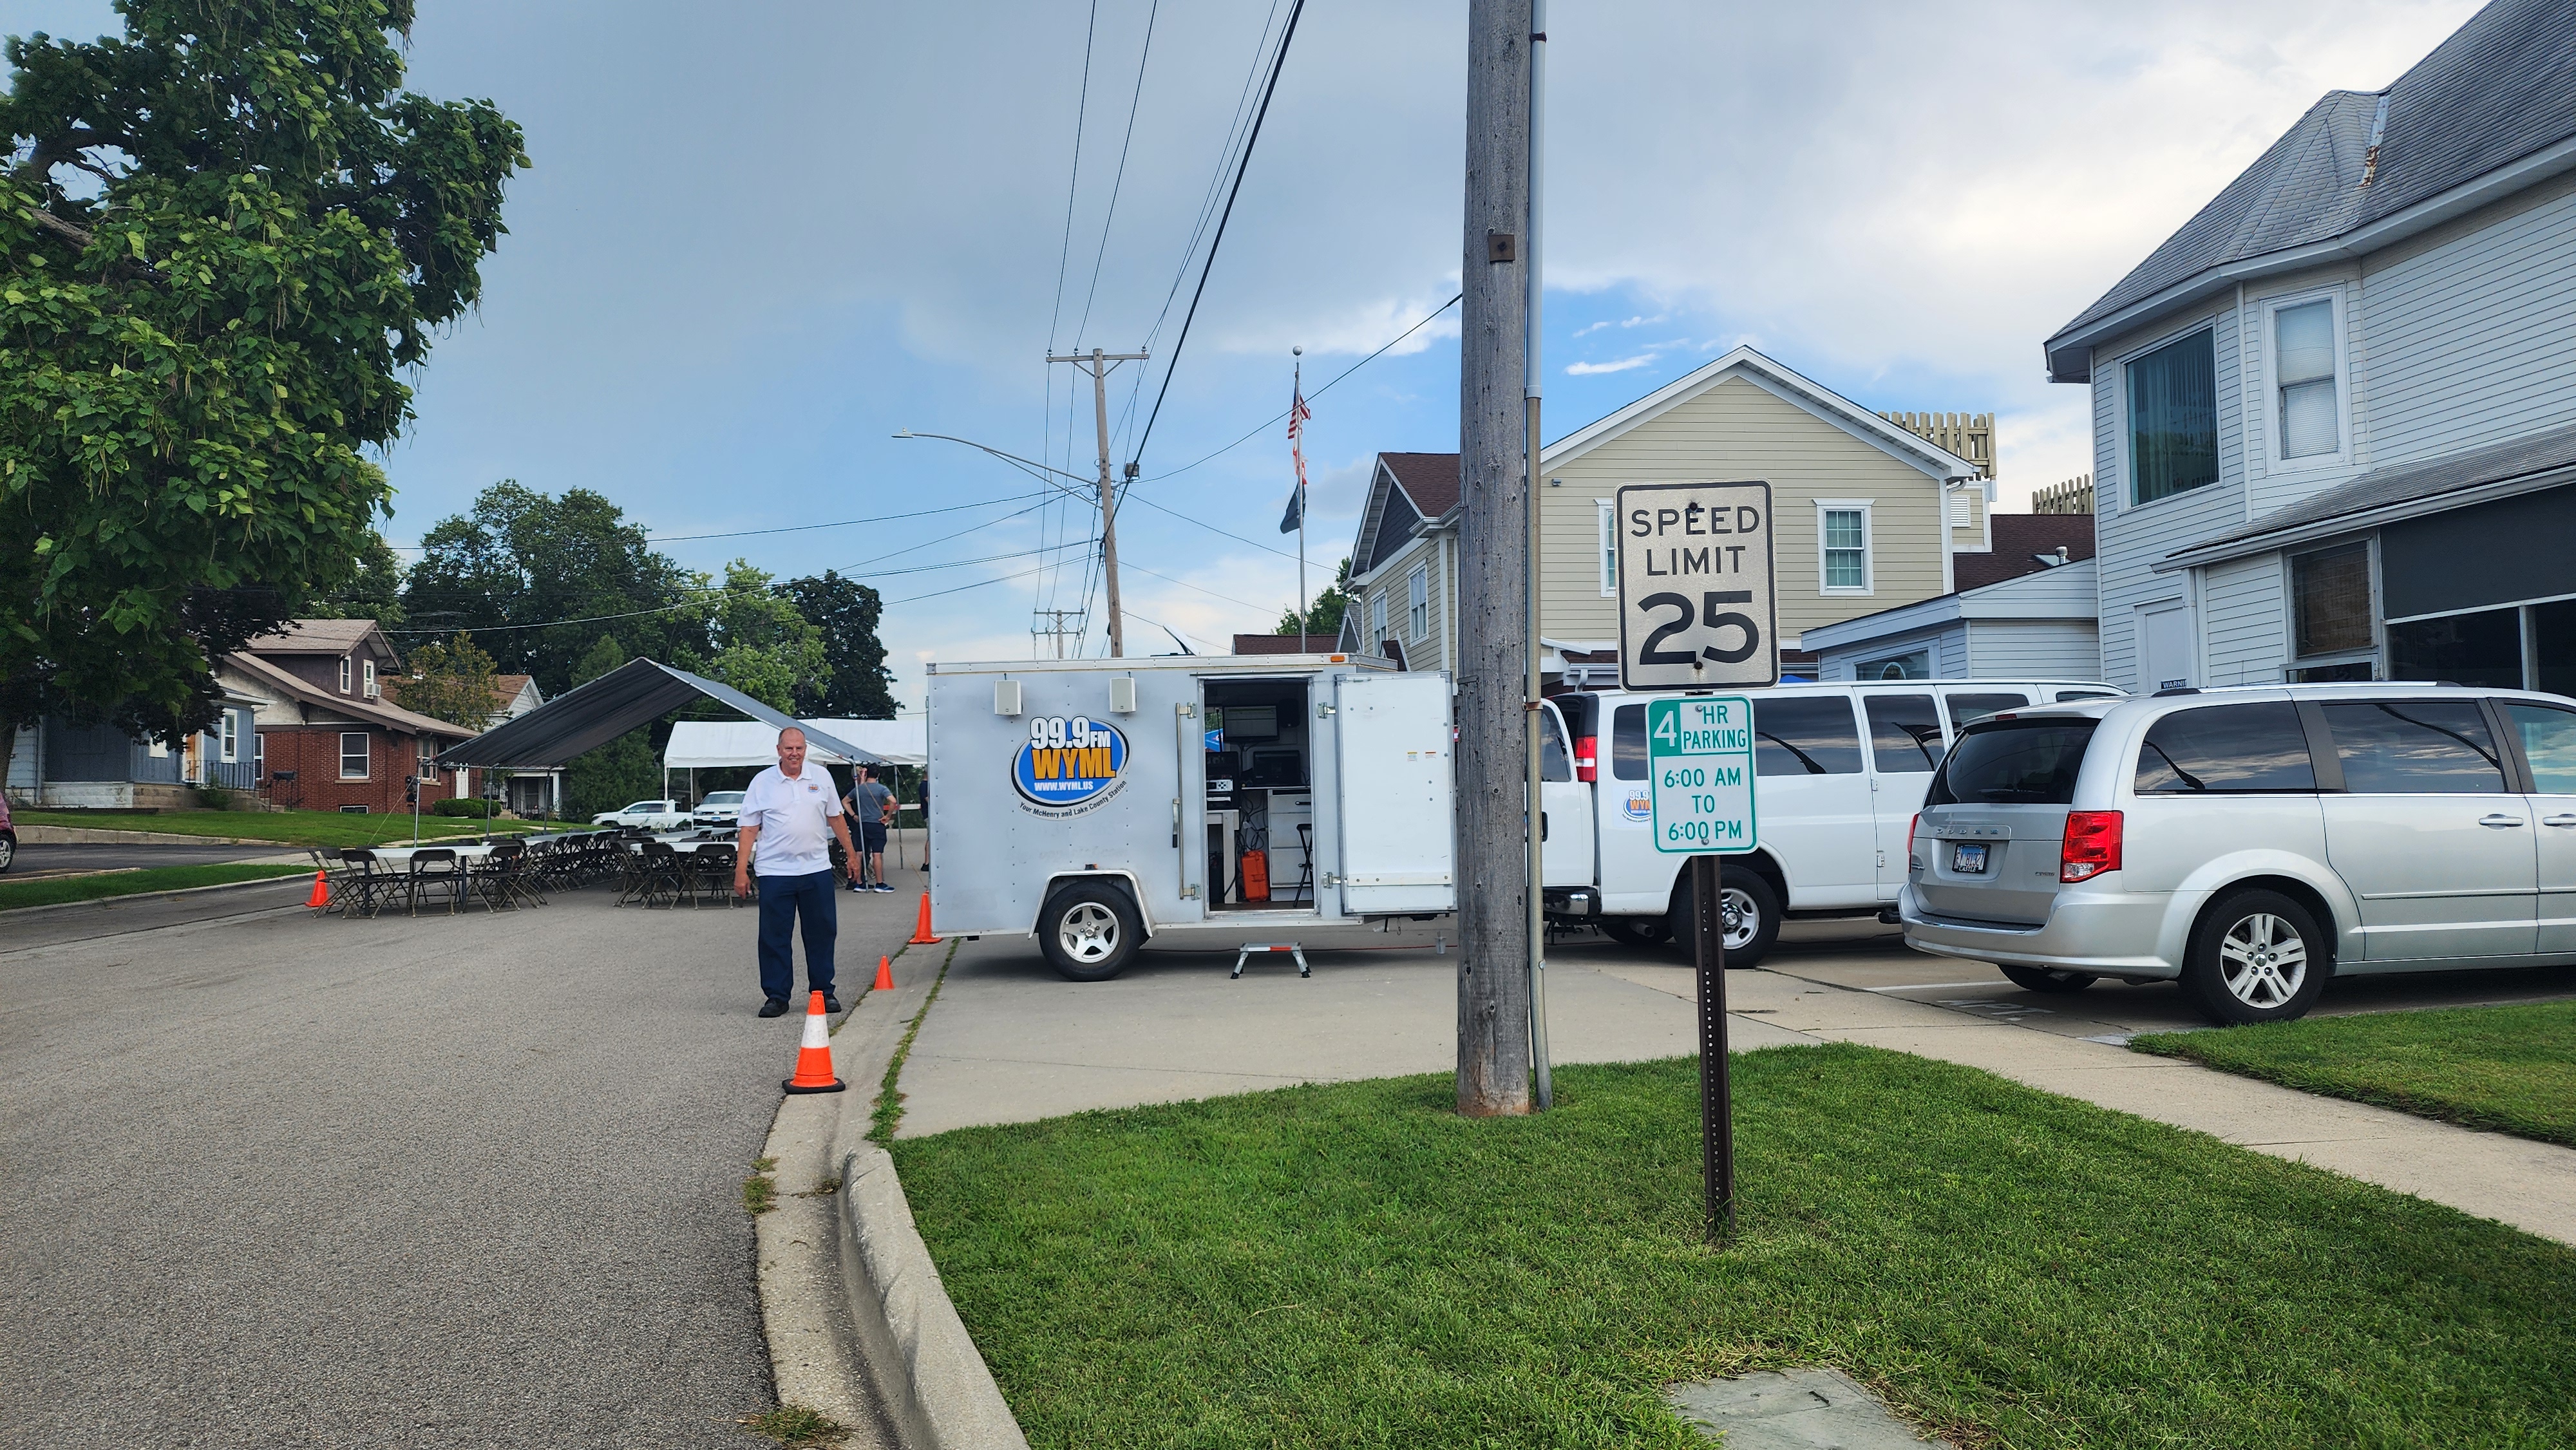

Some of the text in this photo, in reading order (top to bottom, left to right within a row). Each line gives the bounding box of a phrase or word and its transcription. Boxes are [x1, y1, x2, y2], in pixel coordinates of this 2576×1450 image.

[1631, 505, 1760, 537] SPEED
[1646, 545, 1746, 576] LIMIT
[1637, 590, 1760, 665] 25
[1653, 705, 1728, 748] 4 HR
[1683, 729, 1747, 749] PARKING
[1031, 748, 1117, 780] WYML
[1664, 767, 1741, 788] 6:00 AM
[1019, 780, 1127, 819] Your McHenry and Lake County Station
[1034, 780, 1094, 792] WWW.WYML.US
[1691, 795, 1715, 814] TO
[1669, 820, 1742, 841] 6:00 PM
